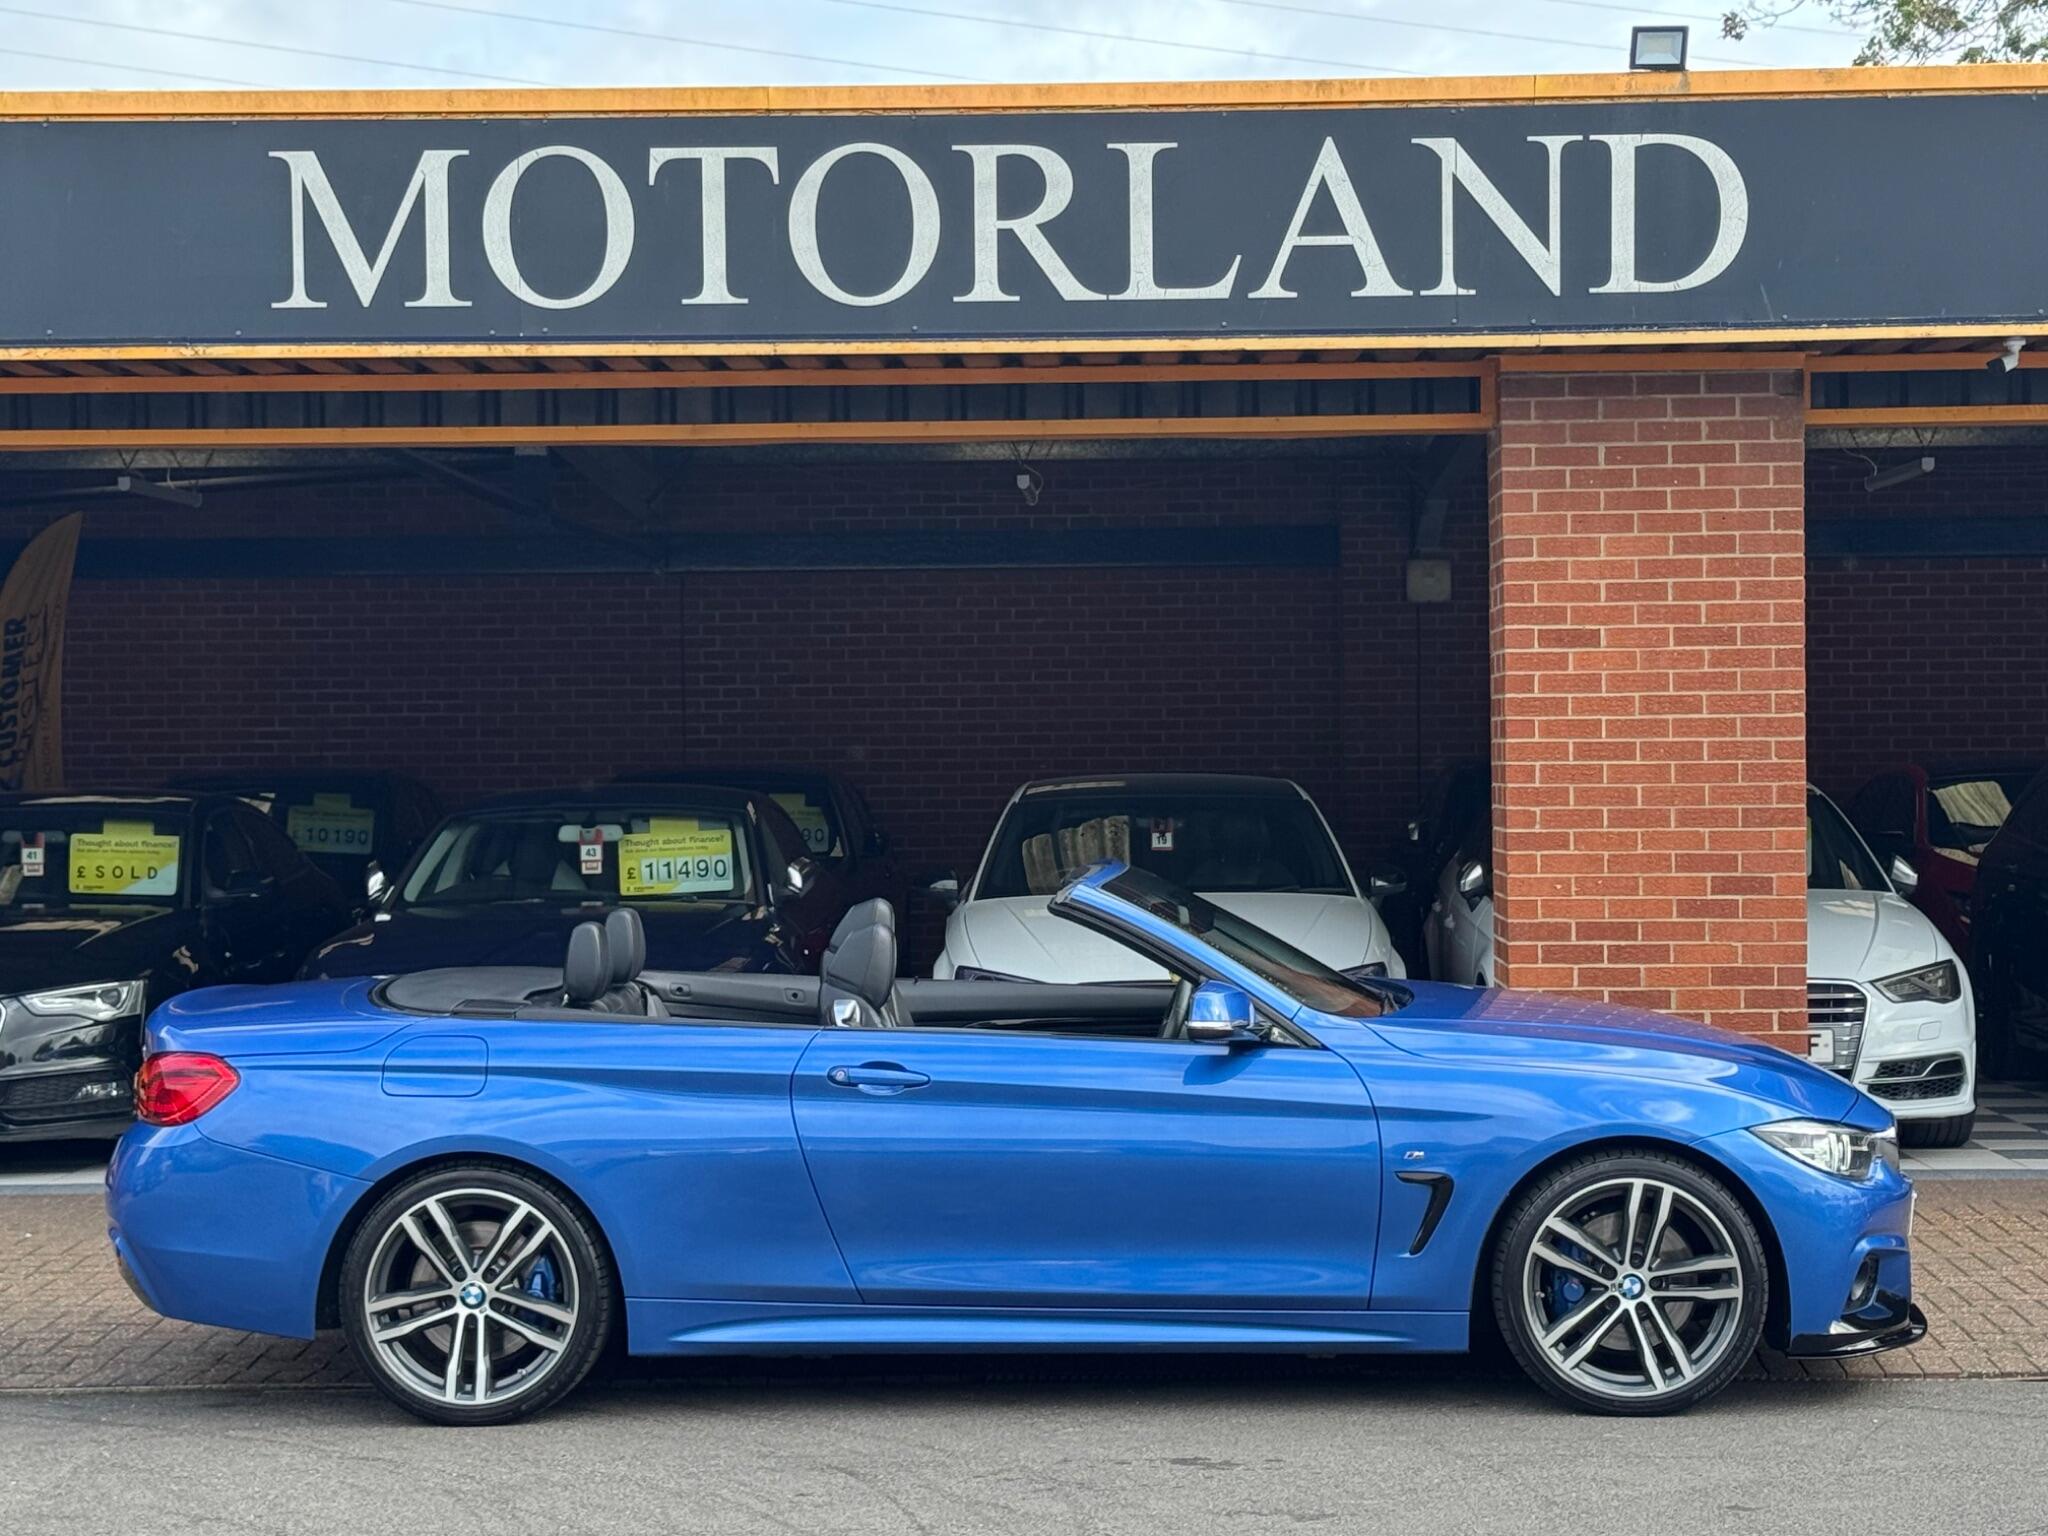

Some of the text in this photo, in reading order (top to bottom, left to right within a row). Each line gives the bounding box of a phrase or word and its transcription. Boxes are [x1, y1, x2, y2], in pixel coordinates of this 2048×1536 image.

[268, 134, 1749, 309] MOTORLAND
[0, 616, 27, 768] CUSTOMER
[306, 828, 368, 845] 10190
[624, 838, 659, 848] Thought
[662, 837, 687, 845] about
[26, 851, 37, 861] 41
[585, 848, 597, 858] 43
[76, 865, 158, 880] £ SOLD
[626, 858, 727, 881] £ 11490
